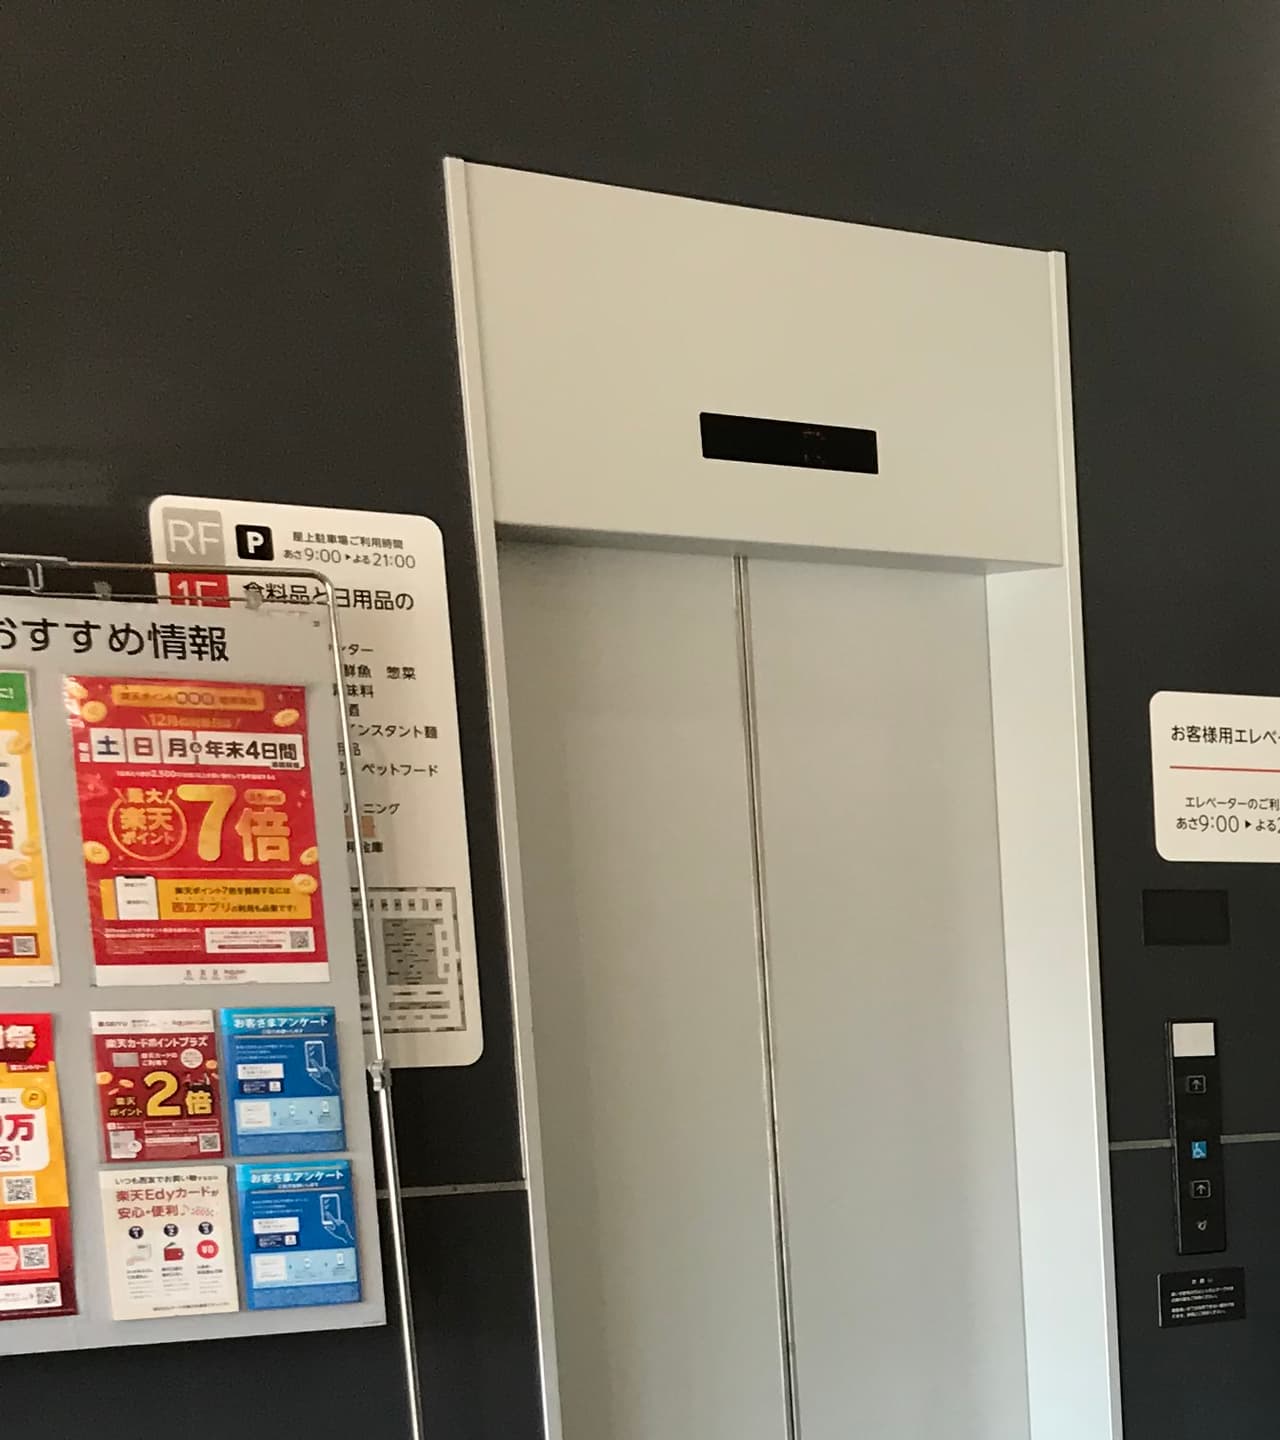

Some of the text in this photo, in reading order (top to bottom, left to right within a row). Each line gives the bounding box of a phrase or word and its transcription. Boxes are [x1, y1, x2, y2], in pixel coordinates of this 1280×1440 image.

[167, 519, 219, 555] RF
[353, 553, 416, 569] よる21:00
[97, 735, 297, 760] 土 日 月 年末4日間
[362, 764, 438, 776] ペットフード
[1176, 815, 1240, 832] あさ9:00
